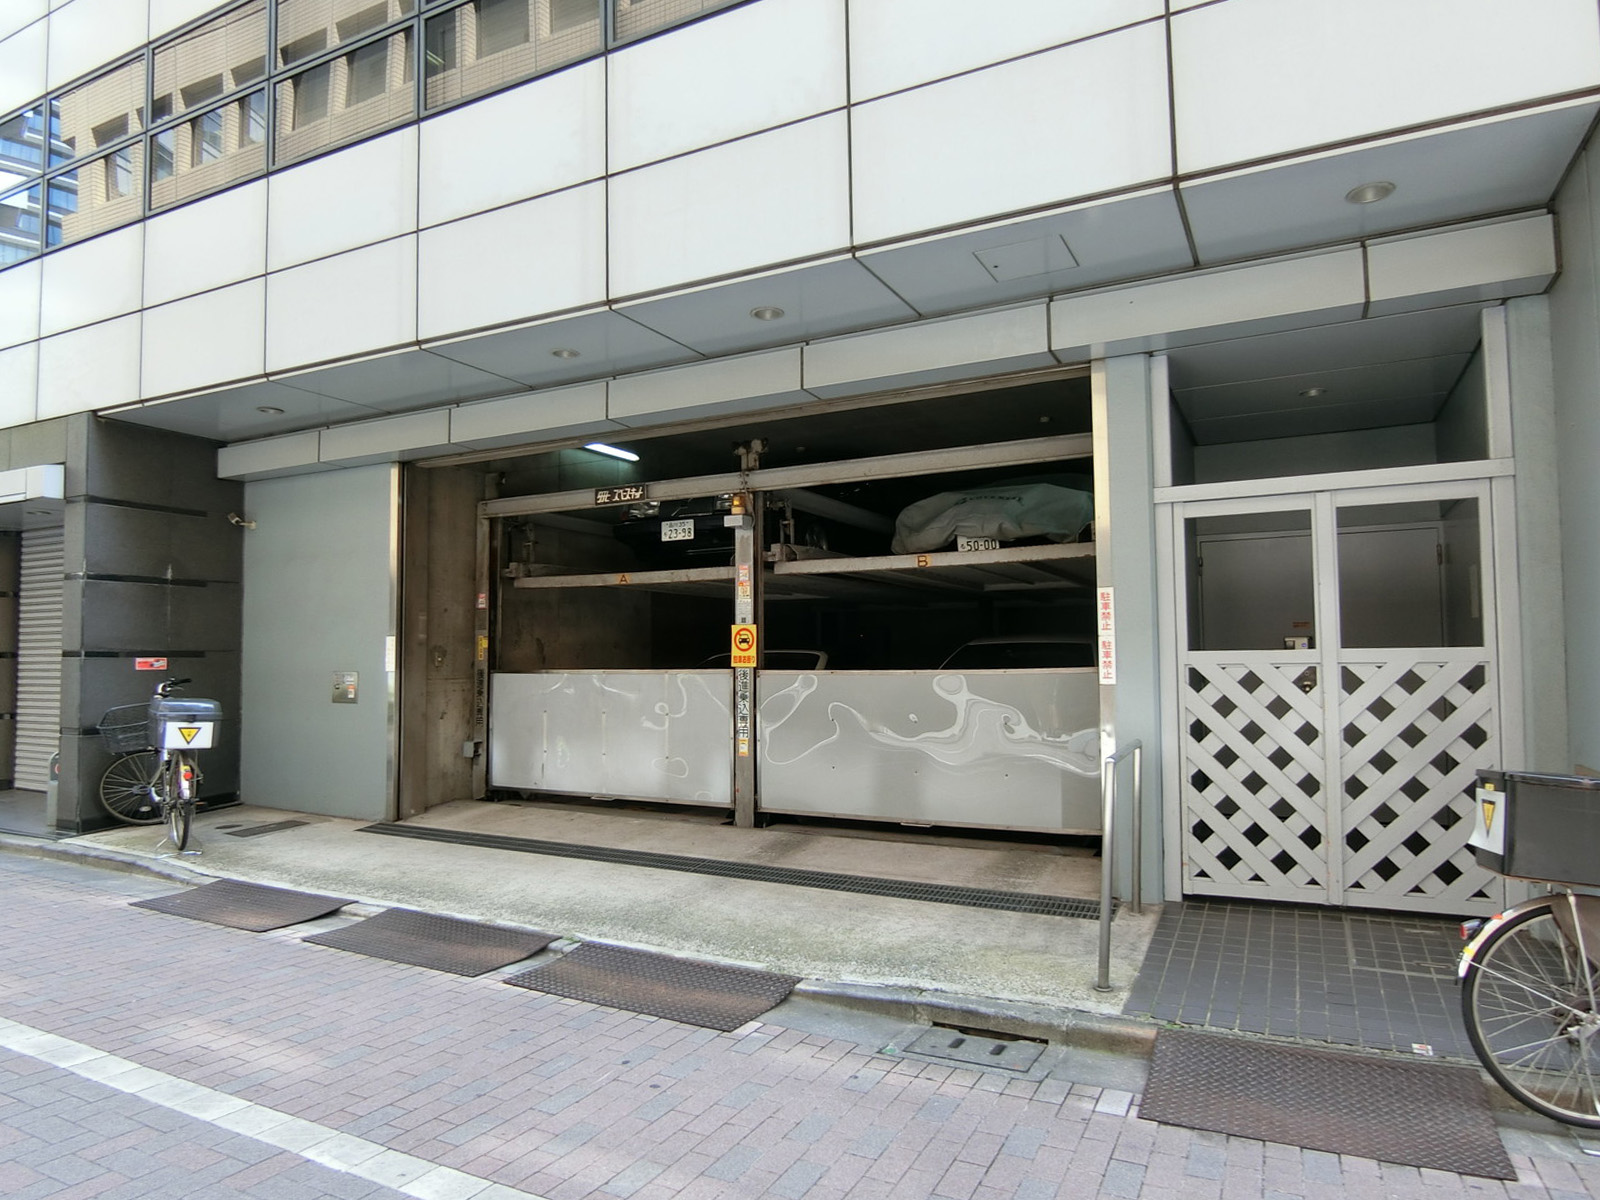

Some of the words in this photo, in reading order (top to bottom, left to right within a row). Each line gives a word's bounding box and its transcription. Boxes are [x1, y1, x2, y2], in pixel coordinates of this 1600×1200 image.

[668, 527, 692, 539] 23-98
[966, 539, 997, 551] 50-00
[917, 555, 928, 567] B
[620, 574, 629, 584] A
[1100, 592, 1112, 630] 駐車禁止
[1102, 641, 1113, 679] 駐車禁止
